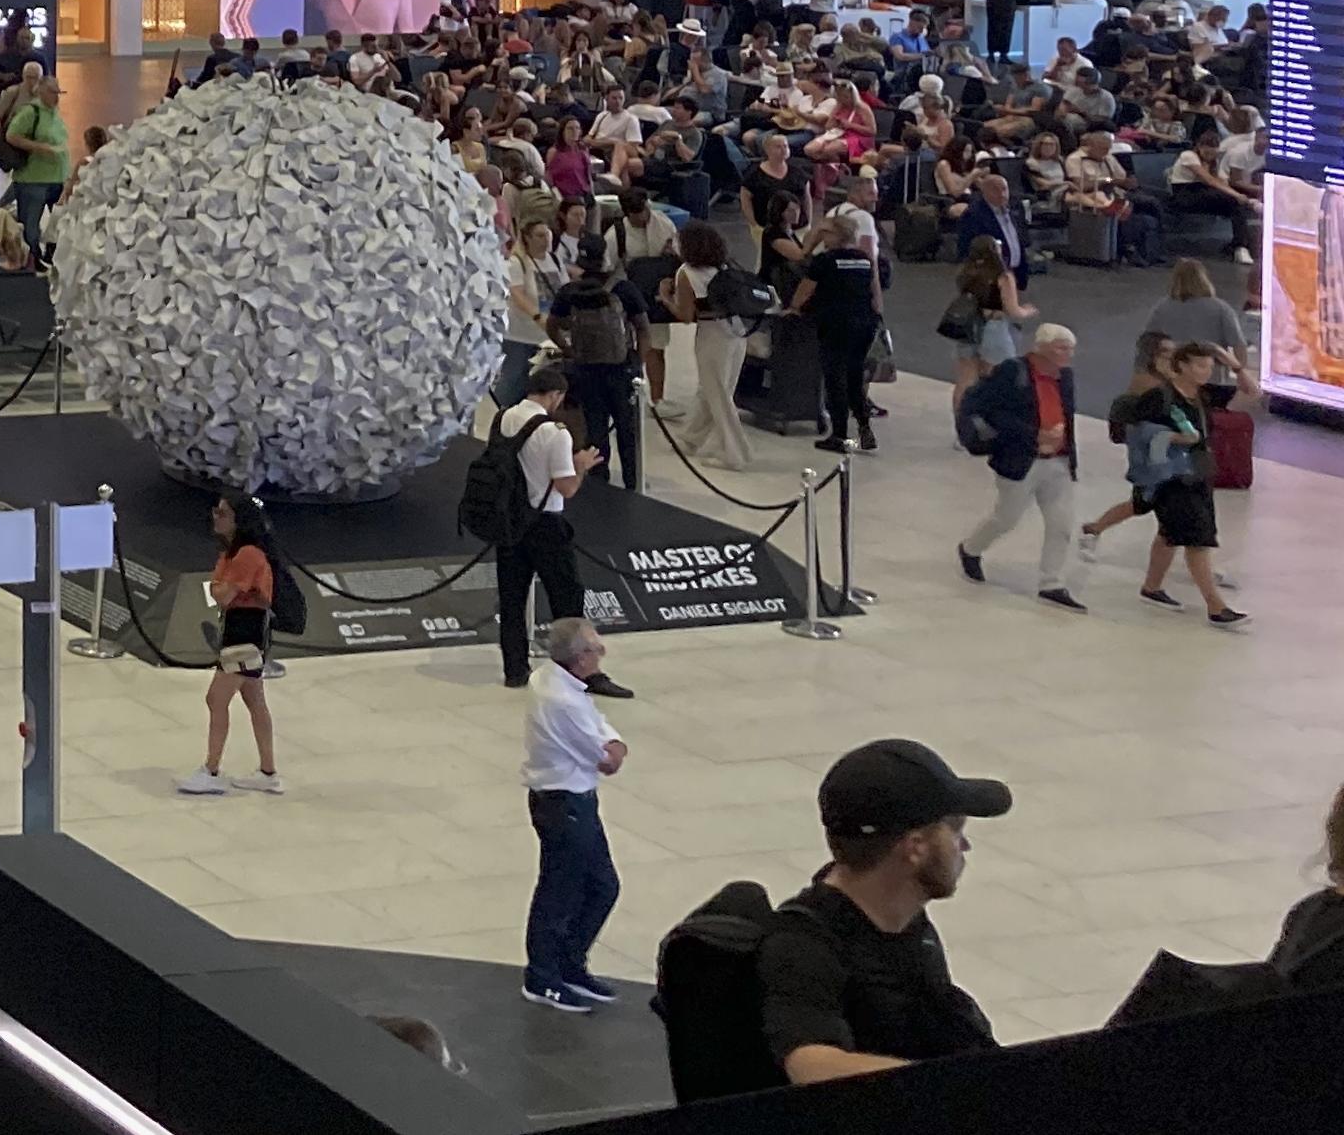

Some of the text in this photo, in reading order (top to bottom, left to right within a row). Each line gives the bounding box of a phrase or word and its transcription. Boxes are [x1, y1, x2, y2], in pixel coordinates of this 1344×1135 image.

[628, 543, 755, 571] MASTER OF
[641, 566, 758, 593] MISTAKES
[658, 597, 787, 621] DANIELE SIGALOT
